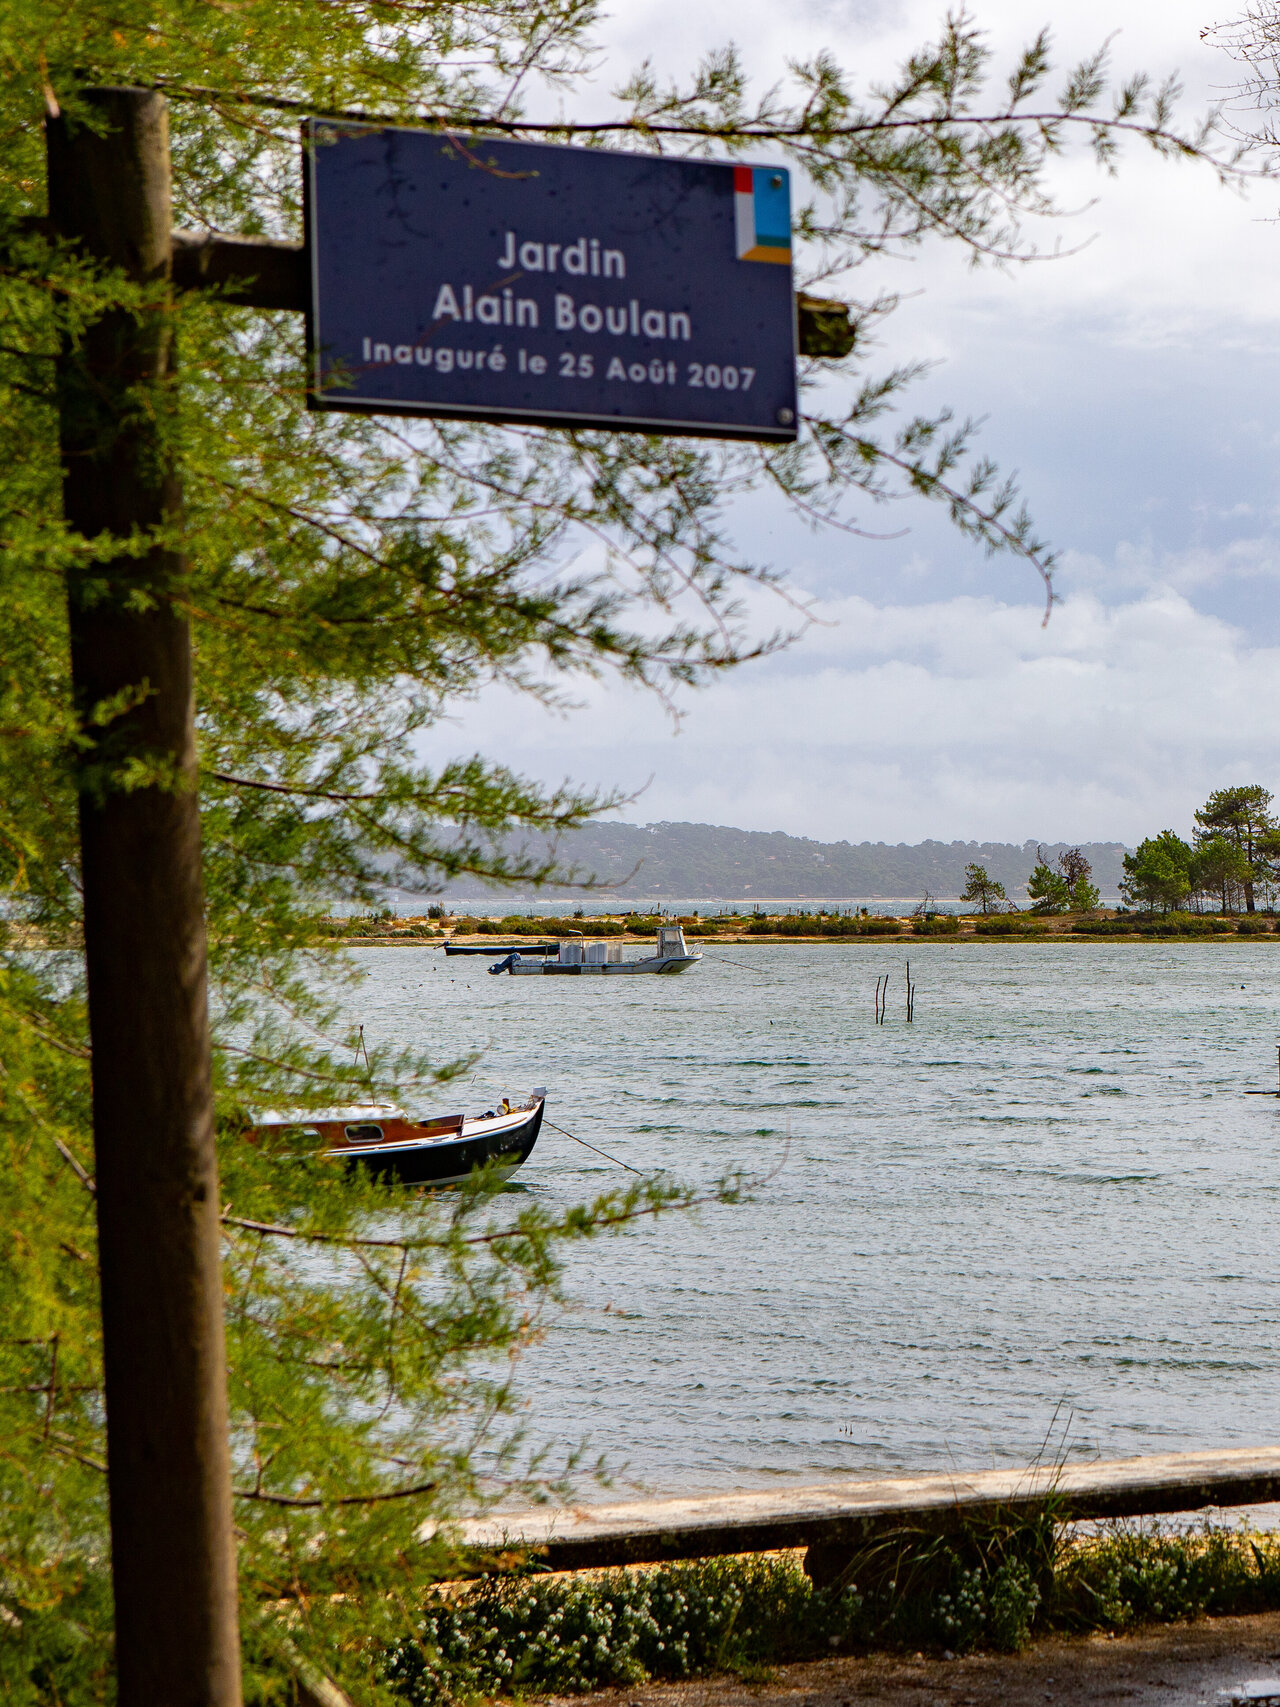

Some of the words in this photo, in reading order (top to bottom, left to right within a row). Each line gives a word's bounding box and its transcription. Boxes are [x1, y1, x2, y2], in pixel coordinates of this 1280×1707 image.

[497, 231, 626, 279] Jardin
[431, 283, 539, 328] Alain
[554, 293, 691, 341] Boulan
[362, 336, 508, 374] Inauguré
[518, 348, 548, 375] le
[558, 352, 594, 379] 25
[605, 356, 677, 385] Août
[687, 362, 757, 392] 2007
